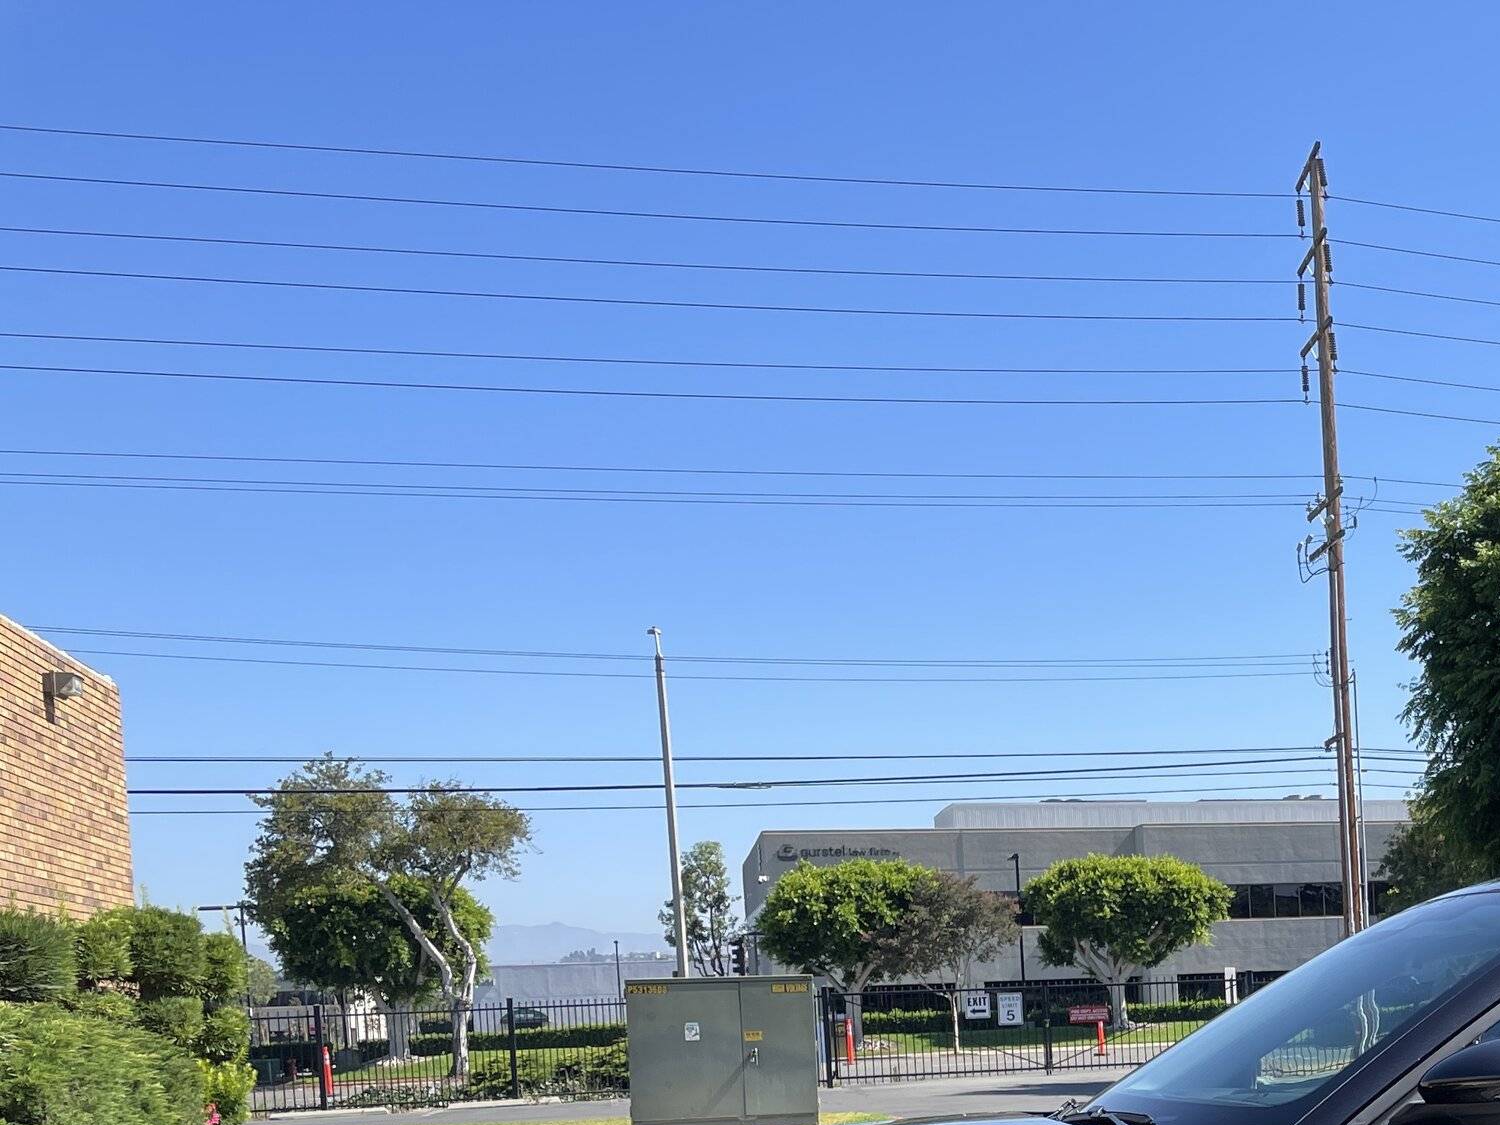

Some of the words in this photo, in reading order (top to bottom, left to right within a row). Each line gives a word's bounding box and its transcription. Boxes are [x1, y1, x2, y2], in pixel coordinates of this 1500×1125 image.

[800, 845, 845, 859] gurstel
[967, 996, 987, 1007] EXIT
[1006, 1009, 1016, 1022] 5
